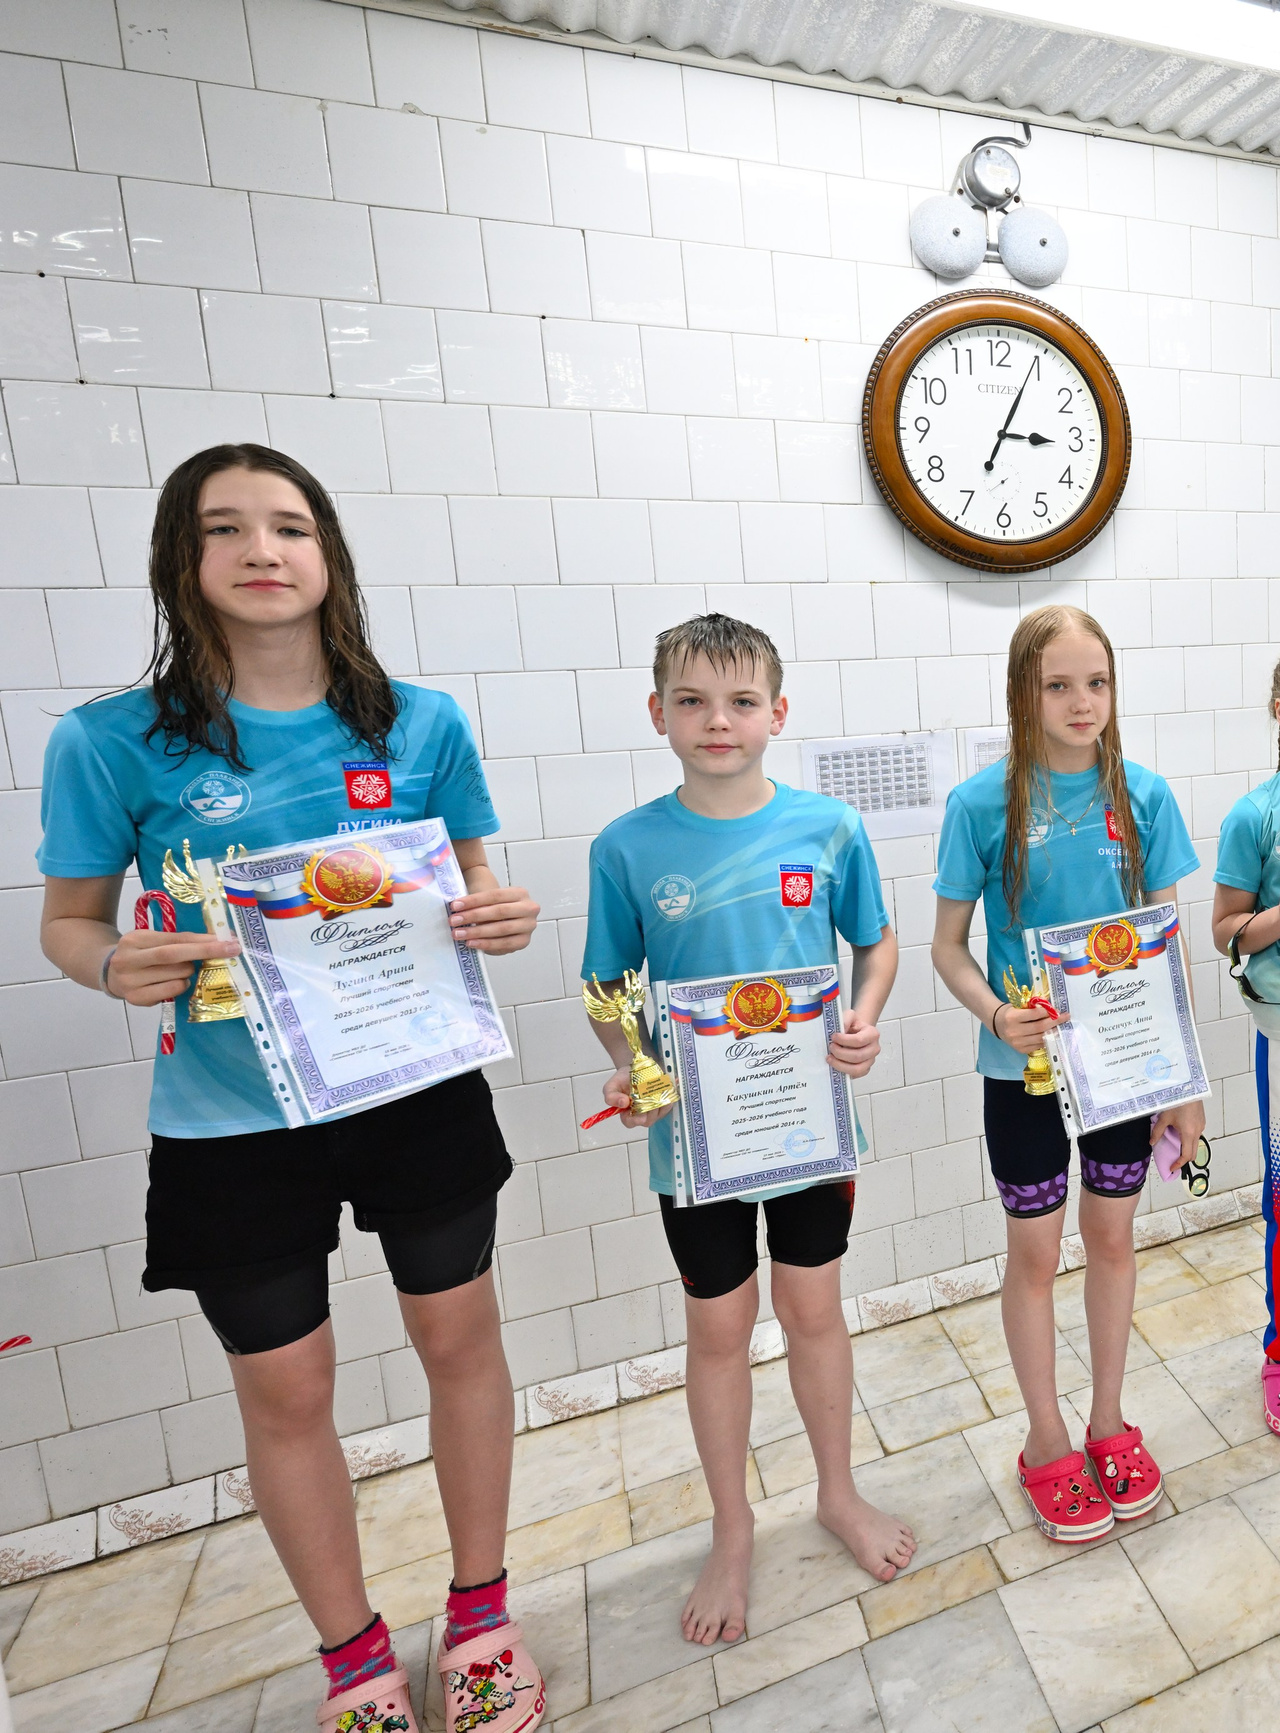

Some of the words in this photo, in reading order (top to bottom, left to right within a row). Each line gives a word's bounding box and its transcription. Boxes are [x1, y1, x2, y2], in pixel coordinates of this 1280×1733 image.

[951, 347, 973, 375] 11
[986, 340, 1012, 367] 12
[1034, 355, 1041, 381] 1
[920, 377, 947, 405] 10
[977, 383, 1021, 396] CITIZEN
[1057, 388, 1073, 414] 2
[914, 416, 930, 443] 9
[1068, 427, 1083, 453] 3
[927, 455, 944, 482] 8
[1058, 465, 1074, 489] 4
[959, 490, 975, 515] 7
[1032, 492, 1048, 517] 5
[996, 502, 1012, 528] 6
[336, 818, 402, 835] ДУГИНА
[1098, 847, 1128, 856] ОКСЕН
[310, 919, 414, 950] Диплом
[328, 945, 406, 970] НАГРАЖДАЕТСЯ
[332, 973, 375, 992] Дугина
[378, 963, 415, 979] Арина
[340, 989, 372, 1002] Лучший
[373, 978, 414, 994] спортсмен
[1090, 979, 1150, 1001] Диплом
[333, 1004, 374, 1020] 2025-2026
[376, 995, 411, 1010] учебного
[412, 989, 430, 998] года
[1098, 1000, 1145, 1017] НАГРАЖДАЕТСЯ
[340, 1024, 363, 1034] среди
[365, 1013, 398, 1028] девушек
[400, 1007, 418, 1017] 2013
[419, 1004, 432, 1012] г.р.
[1098, 1020, 1133, 1034] Оксенчук
[1134, 1015, 1153, 1024] Анна
[725, 1042, 801, 1065] Диплом
[735, 1067, 794, 1083] НАГРАЖДАЕТСЯ
[726, 1088, 774, 1102] Какушкин
[776, 1081, 807, 1093] Артём
[739, 1102, 764, 1111] Лучший
[765, 1096, 796, 1106] спортсмен
[731, 1114, 763, 1125] 2025-2026
[764, 1109, 792, 1119] учебного
[734, 1129, 753, 1137] среди
[754, 1124, 779, 1133] юношей
[470, 1664, 496, 1676] 100%
[494, 1656, 508, 1672] I
